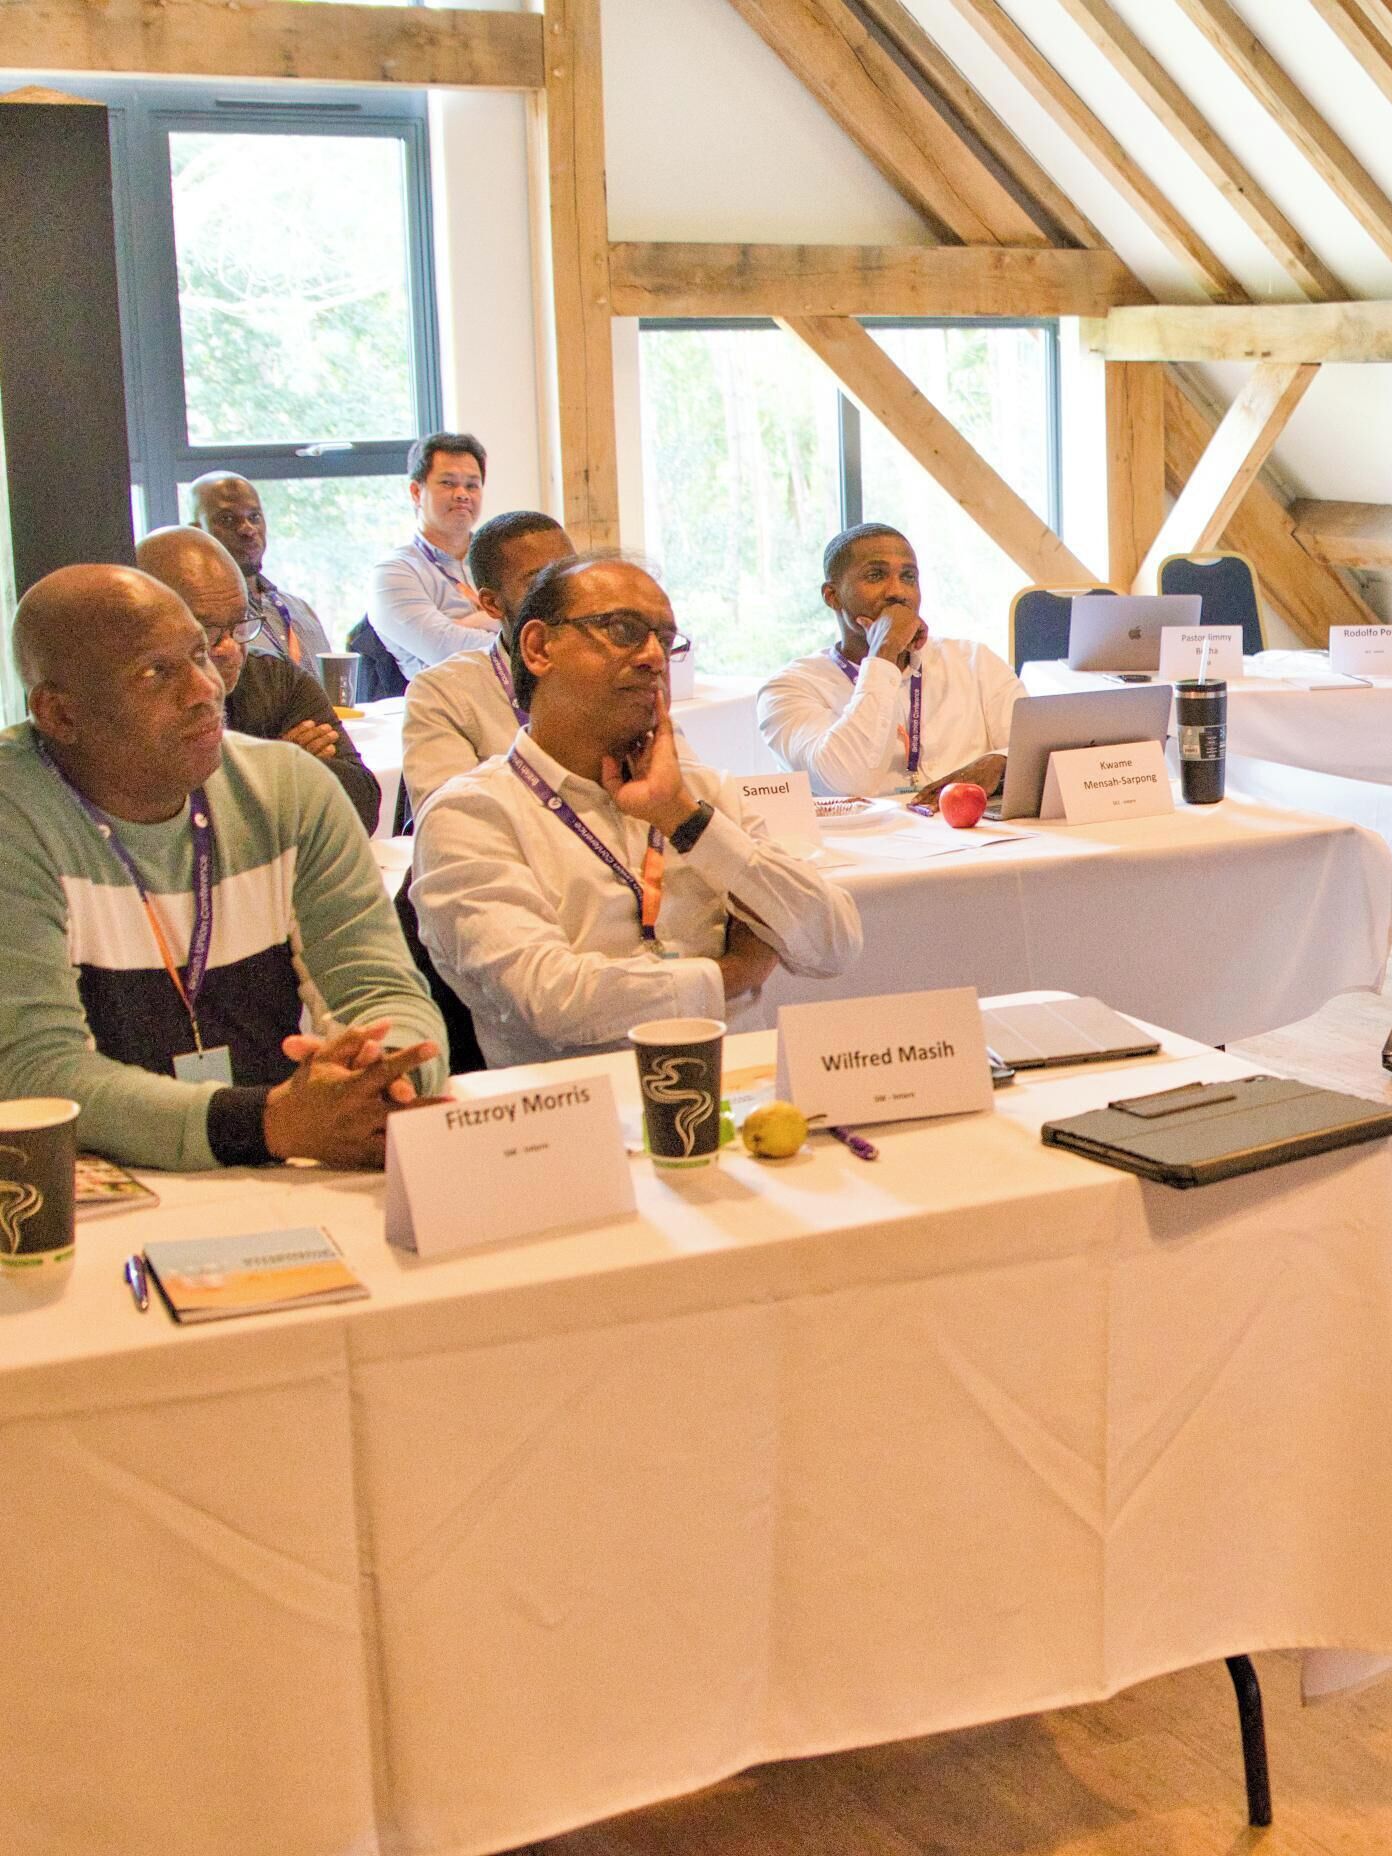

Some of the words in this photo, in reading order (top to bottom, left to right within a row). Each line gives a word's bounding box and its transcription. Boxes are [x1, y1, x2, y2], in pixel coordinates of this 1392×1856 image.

[1344, 628, 1378, 637] Rodolfo
[912, 688, 920, 719] Conference
[1099, 759, 1133, 770] Kwame
[742, 781, 790, 797] Samuel
[1083, 773, 1158, 790] Mensah-Sarpong
[573, 820, 615, 865] Conference
[821, 1047, 893, 1072] Wilfred
[898, 1040, 956, 1063] Masih
[445, 1101, 516, 1131] Fitzroy
[521, 1085, 591, 1114] Morris
